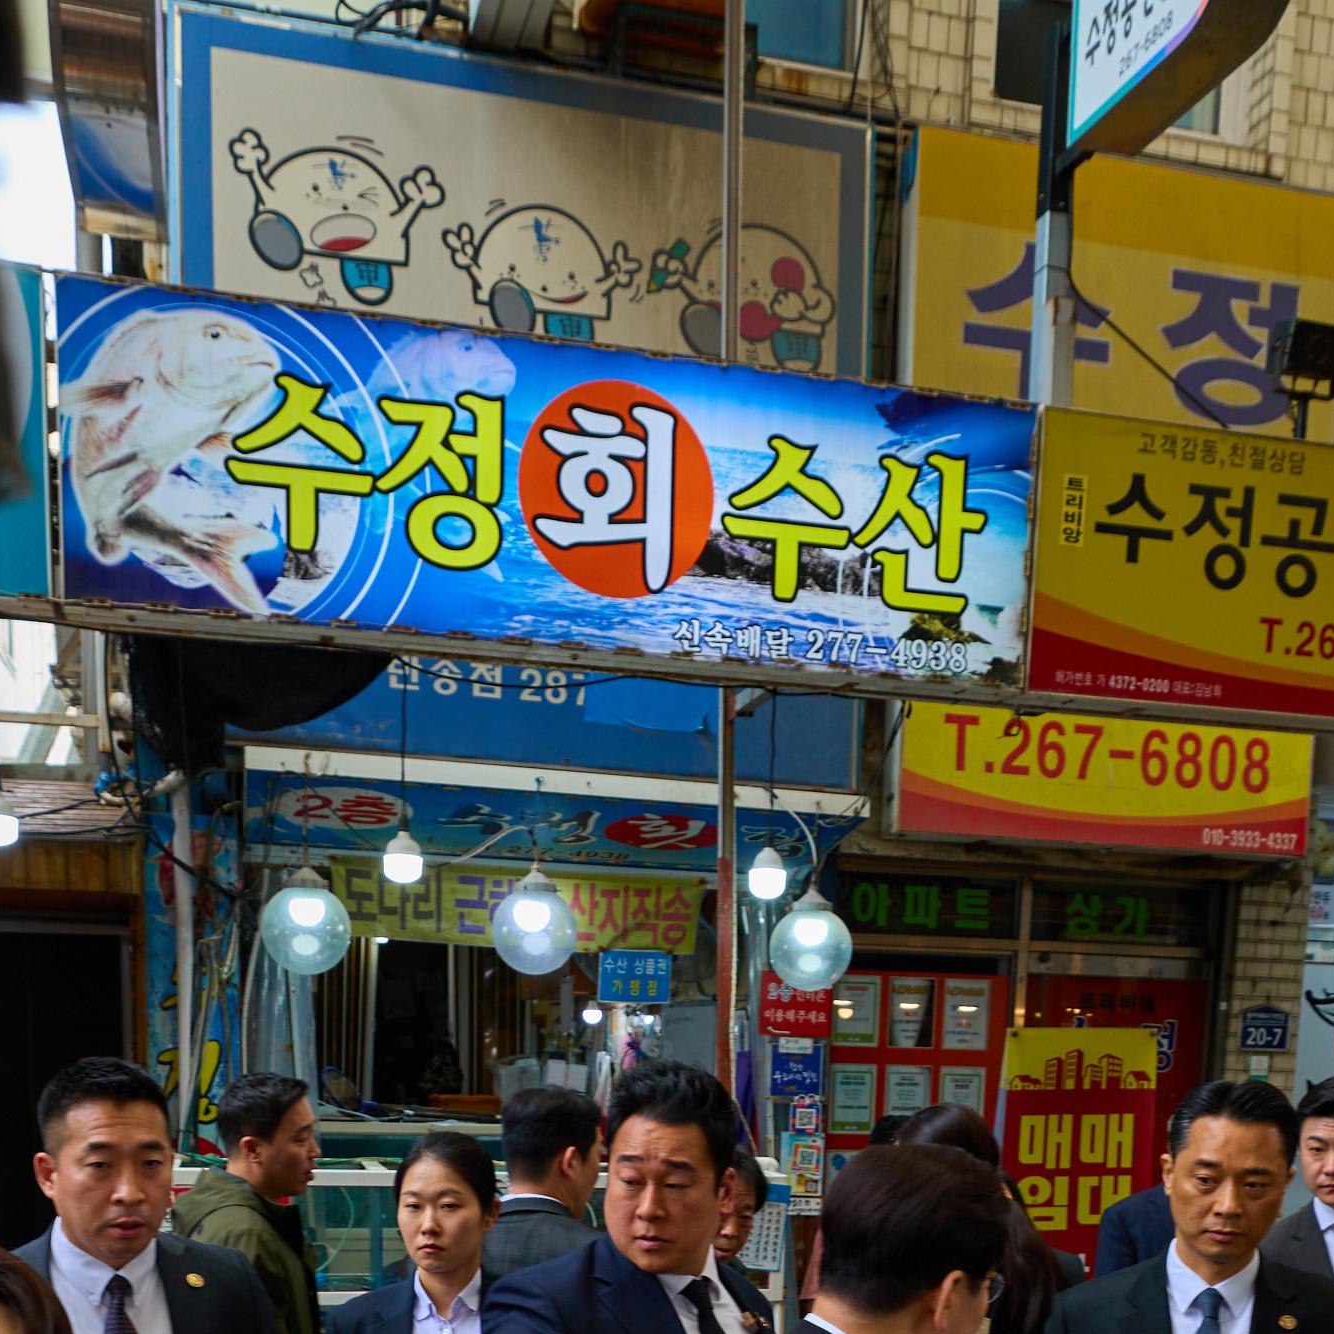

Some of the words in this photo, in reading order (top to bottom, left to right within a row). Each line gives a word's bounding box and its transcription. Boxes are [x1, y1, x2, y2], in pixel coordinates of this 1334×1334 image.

[1119, 10, 1173, 77] 267-6808
[226, 375, 506, 570] 수정
[533, 404, 678, 594] 회
[722, 436, 987, 613] 수산
[673, 618, 794, 660] 신속배달
[805, 629, 970, 675] 277-4938
[944, 712, 1270, 796] T.267-6808
[1202, 827, 1298, 851] 010-3933-4337
[852, 882, 989, 930] 아파트
[1067, 893, 1151, 939] 상가
[1245, 1026, 1283, 1047] 20-7
[1018, 1113, 1135, 1170] 매매
